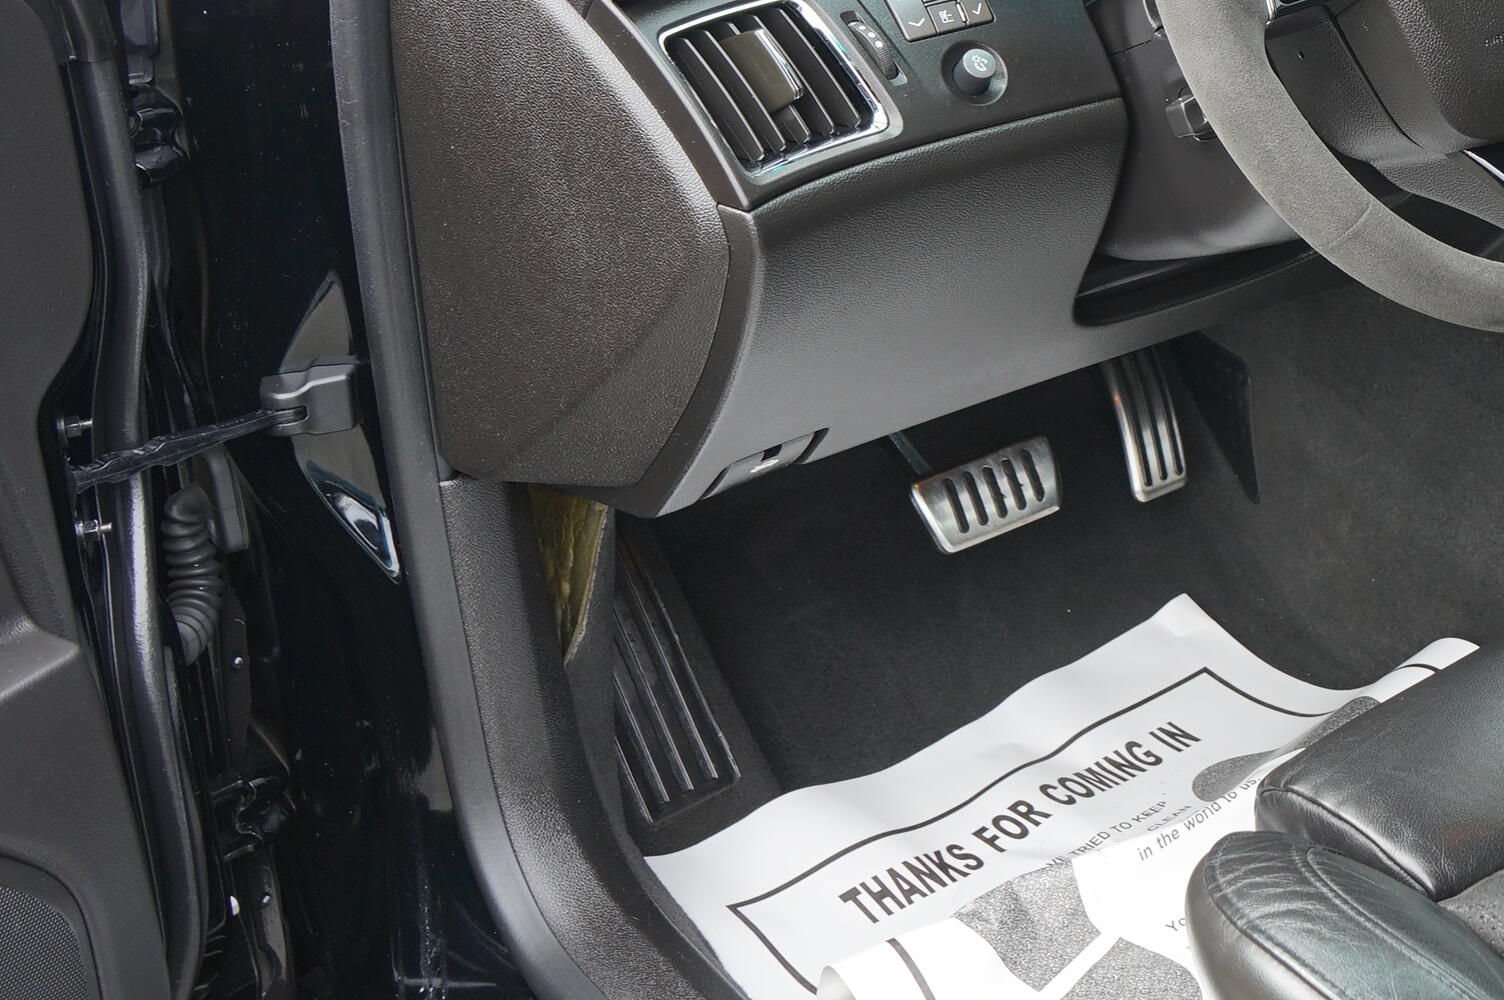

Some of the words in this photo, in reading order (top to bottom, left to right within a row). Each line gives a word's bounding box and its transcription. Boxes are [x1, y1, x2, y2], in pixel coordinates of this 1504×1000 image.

[838, 843, 985, 924] THANKS
[971, 799, 1053, 853] FOR
[1038, 740, 1164, 806] COMING
[1148, 721, 1202, 753] IN
[1067, 830, 1112, 857] TRIED
[1107, 820, 1134, 833] TO
[1131, 800, 1168, 824] KEEP
[1136, 845, 1154, 863] in
[1156, 828, 1181, 850] the
